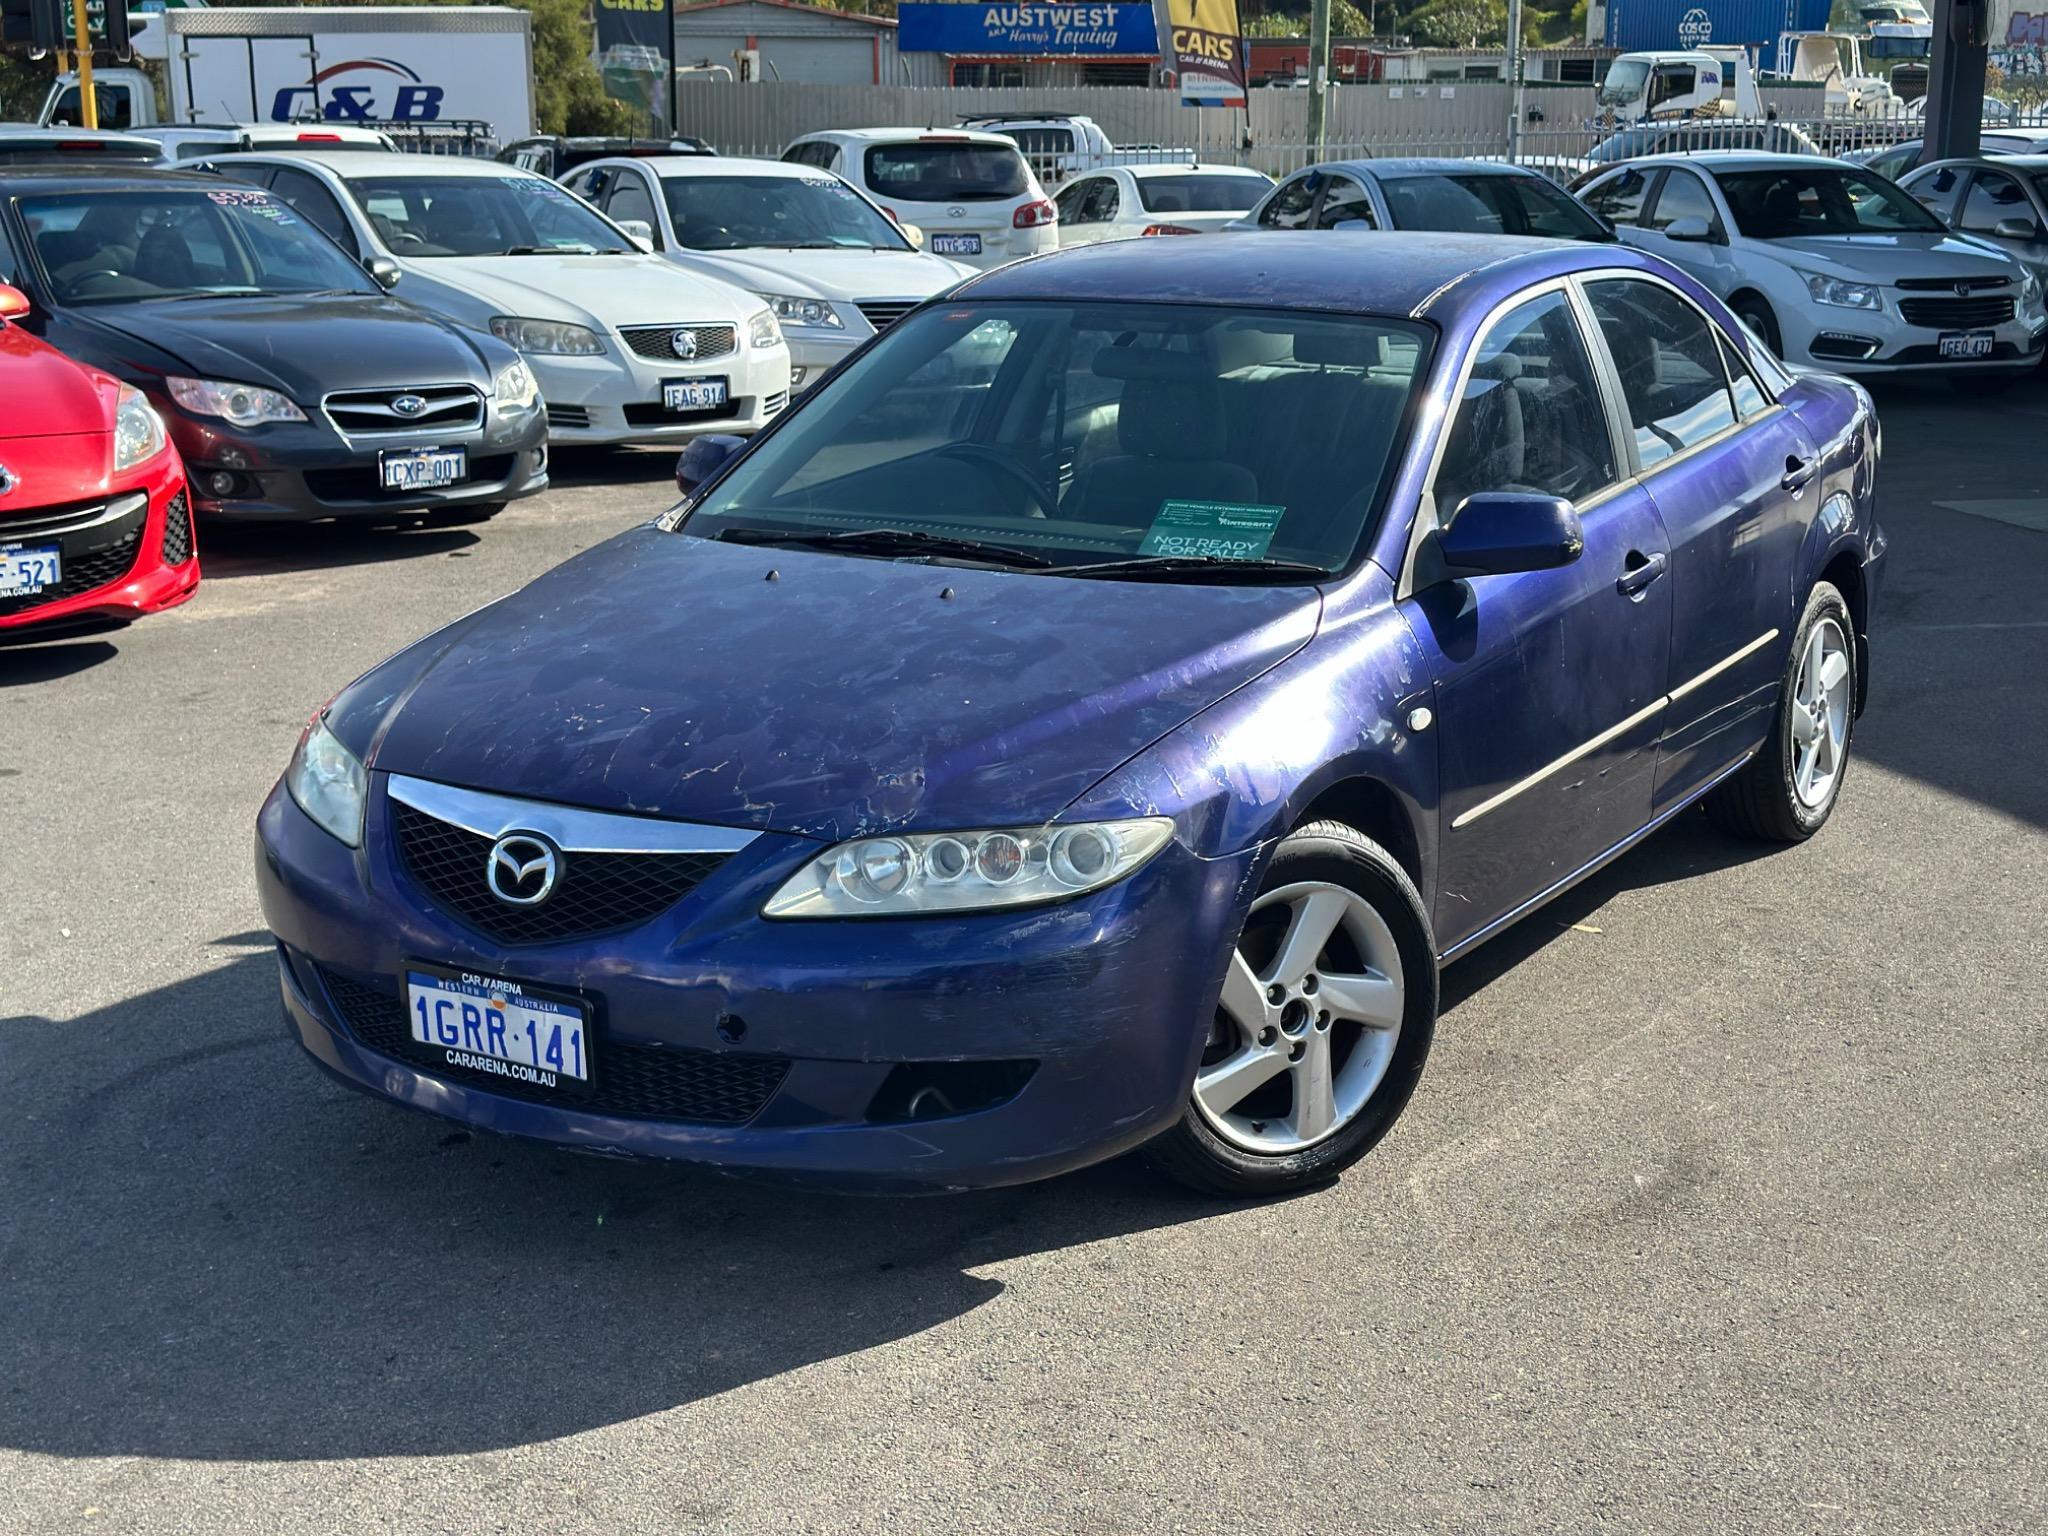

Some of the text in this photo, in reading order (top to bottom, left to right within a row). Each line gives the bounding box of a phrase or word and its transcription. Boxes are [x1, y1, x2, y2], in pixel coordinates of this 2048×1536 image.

[983, 7, 1119, 27] AUSTWEST
[1054, 25, 1118, 49] Towing
[1678, 21, 1712, 34] COSCO
[1172, 30, 1233, 61] CARS
[1153, 535, 1260, 551] NOT READY
[1157, 543, 1246, 560] FOR SALE
[461, 972, 482, 986] CAR
[438, 980, 559, 1014] WESTERN AUSTRALIA
[446, 1050, 556, 1088] CARARENA.COM.AU
